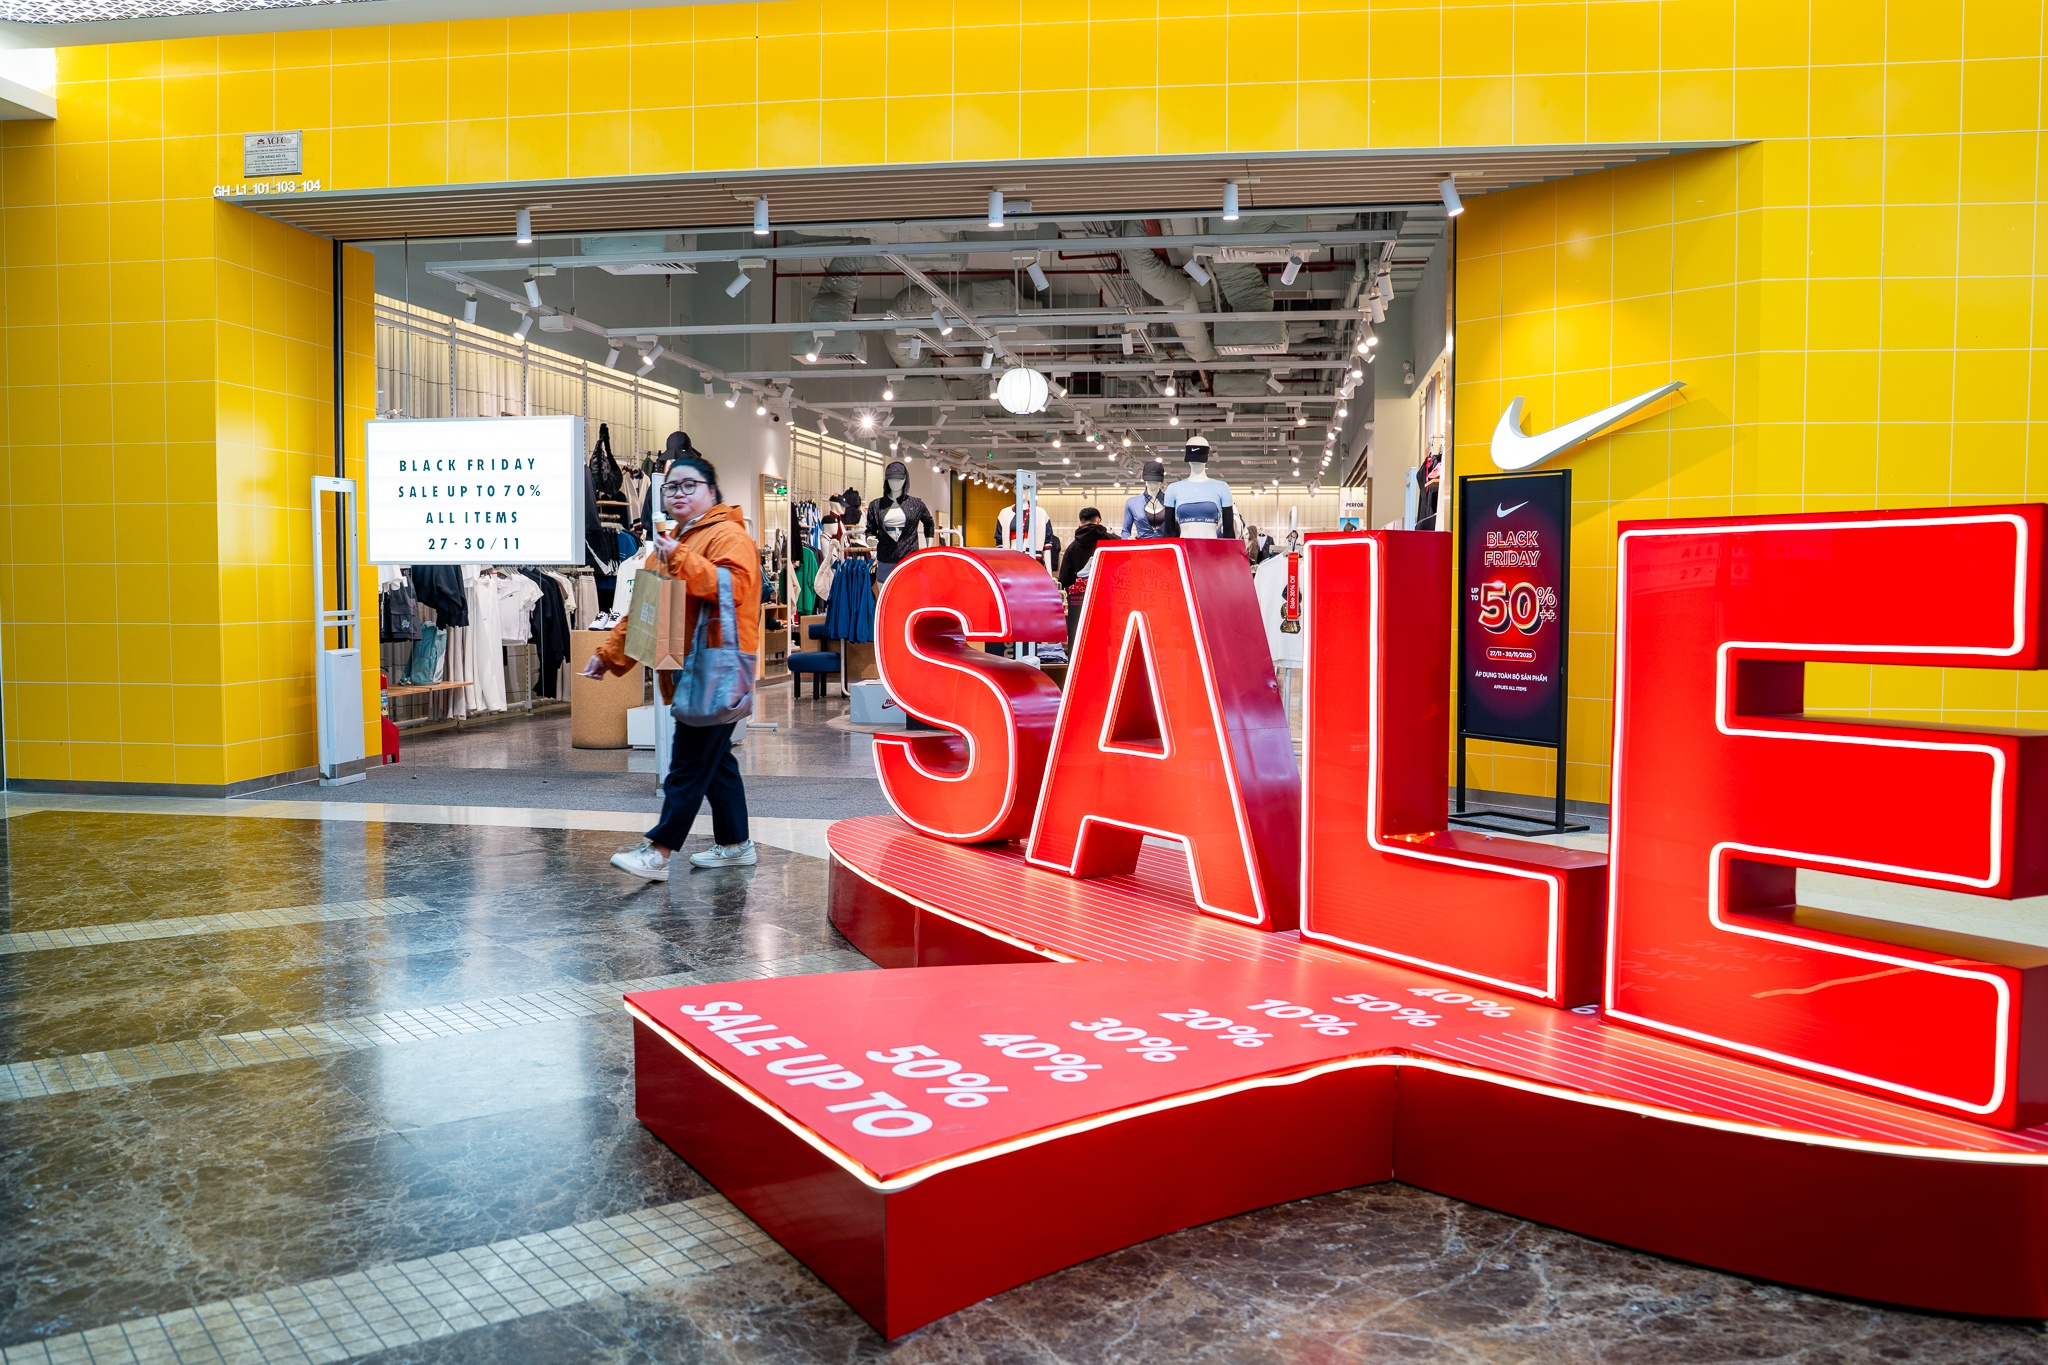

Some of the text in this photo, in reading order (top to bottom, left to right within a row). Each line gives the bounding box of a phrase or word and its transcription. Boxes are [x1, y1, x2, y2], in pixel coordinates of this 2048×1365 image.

[399, 458, 536, 472] BLACK FRIDAY
[398, 484, 541, 498] SALE UP TO 70%
[426, 511, 518, 524] ALL ITEMS
[1486, 530, 1539, 548] BLACK
[1484, 550, 1541, 568] FRIDAY
[1483, 671, 1497, 679] DỤNG
[1498, 672, 1512, 680] TOÀN
[1512, 673, 1520, 681] BỘ
[871, 505, 2048, 1128] SALE
[1246, 998, 1359, 1037] 10%
[1331, 992, 1443, 1028] 50%
[1406, 985, 1516, 1019] 40%
[1069, 1016, 1189, 1063] 30%
[1158, 1007, 1274, 1049] 20%
[679, 1000, 934, 1138] SALE UP TO
[979, 1032, 1103, 1084] 40%
[866, 1044, 1009, 1109] 50%
